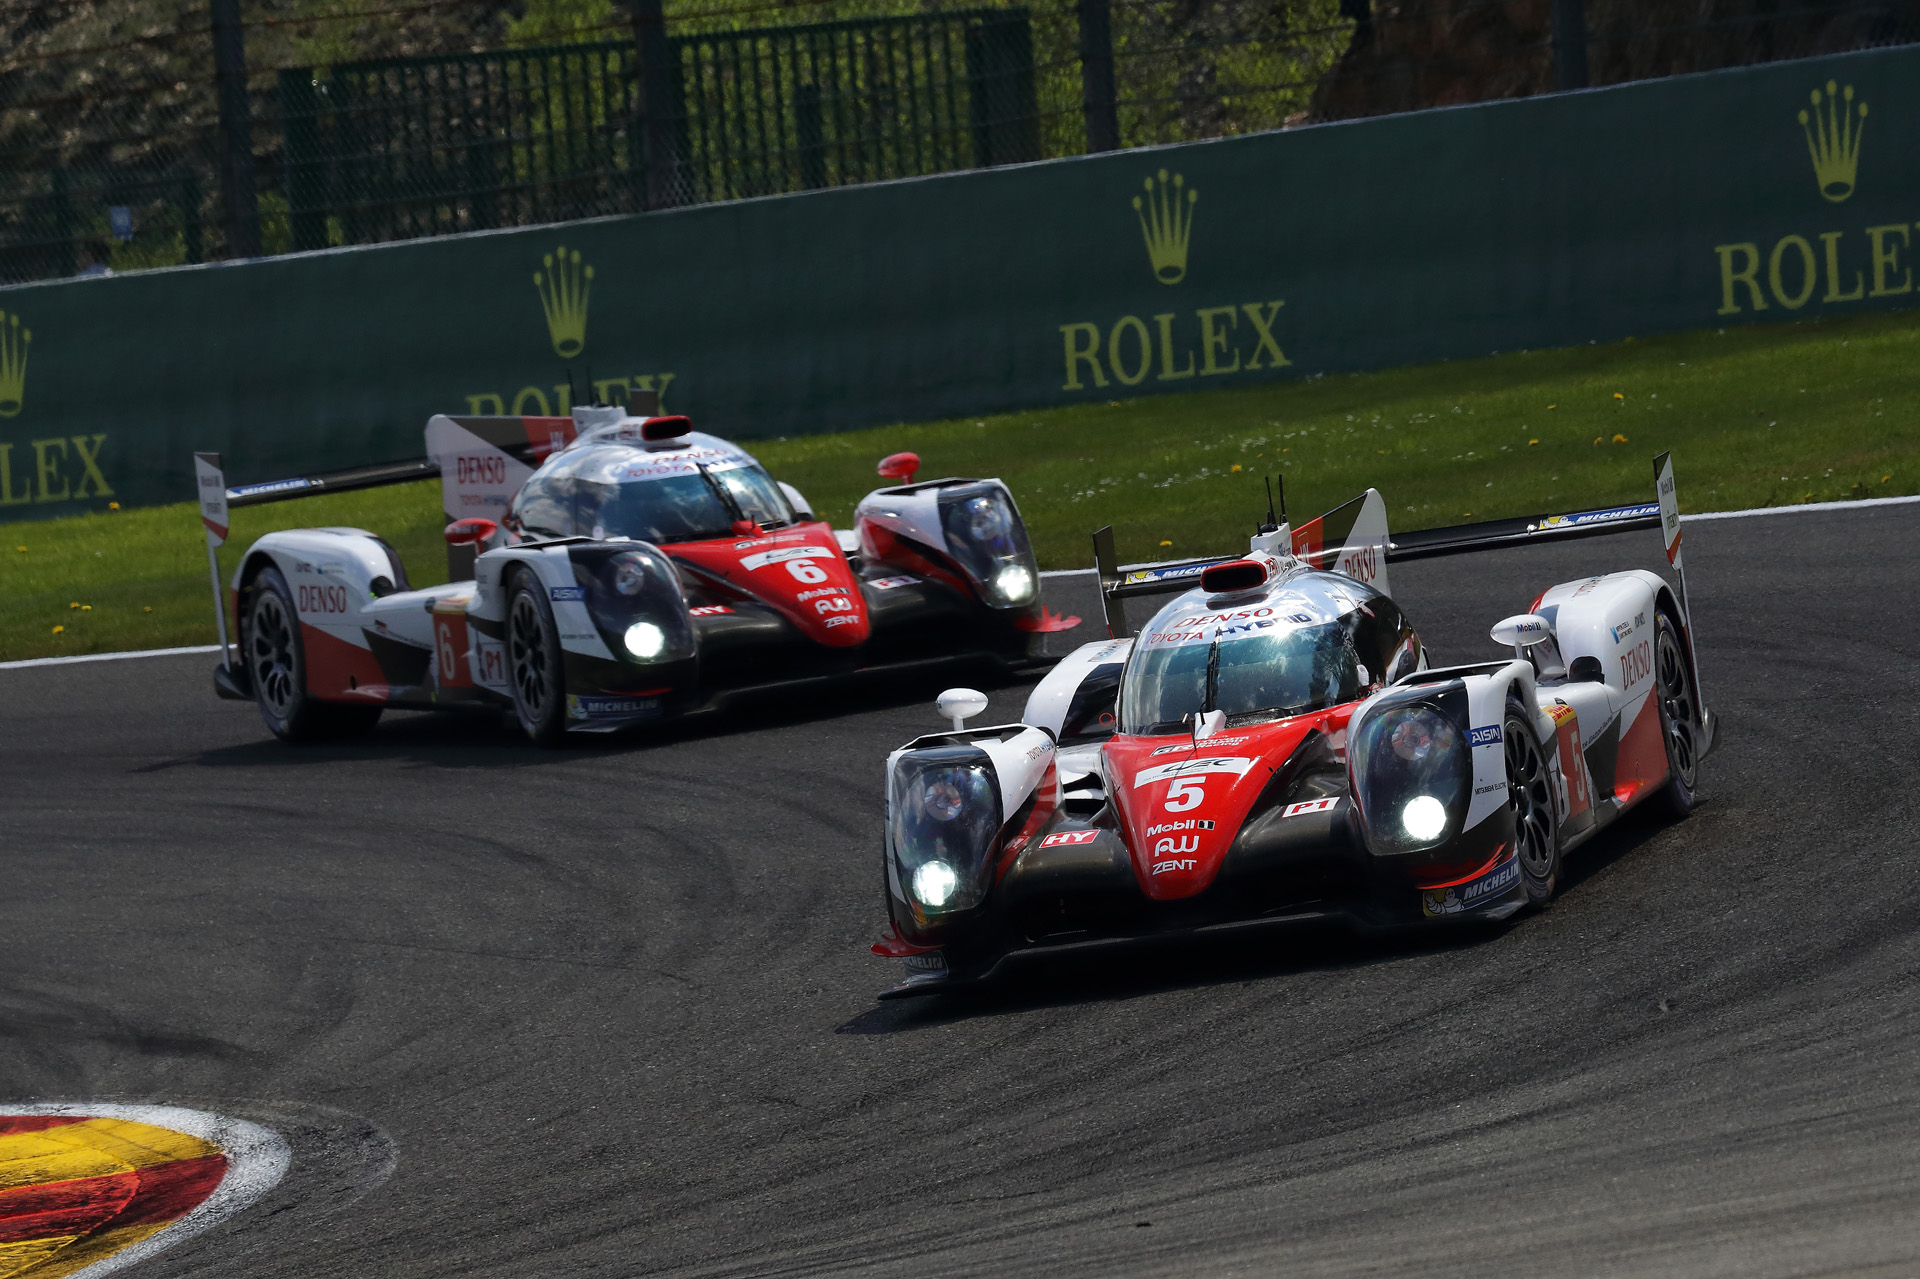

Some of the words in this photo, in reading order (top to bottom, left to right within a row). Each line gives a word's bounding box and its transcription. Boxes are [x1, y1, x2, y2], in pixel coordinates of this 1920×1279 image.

[1714, 222, 1920, 315] ROLE
[1059, 300, 1293, 391] ROLEX
[457, 456, 506, 484] DENSO
[626, 464, 695, 478] TOYOTA
[1576, 506, 1660, 523] MICHELIN
[785, 559, 828, 584] 6
[1343, 544, 1377, 583] DENSO
[298, 585, 347, 614] DENSO
[797, 587, 837, 603] Mobil
[823, 615, 860, 629] ZENT
[1146, 631, 1204, 645] TOYOTA
[1221, 612, 1313, 635] HYBRID
[1173, 607, 1274, 629] DENSO
[439, 622, 456, 680] 6
[485, 650, 503, 680] P1
[1619, 639, 1651, 691] DENSO
[588, 701, 657, 713] MICHELIN
[1471, 726, 1501, 745] AISIN
[1570, 731, 1586, 802] 5
[1164, 776, 1206, 813] 5
[1291, 800, 1330, 814] P1
[1046, 831, 1093, 846] HY
[1146, 819, 1196, 838] Mobil
[1152, 859, 1198, 876] ZENT
[1463, 860, 1519, 901] MICHELIN
